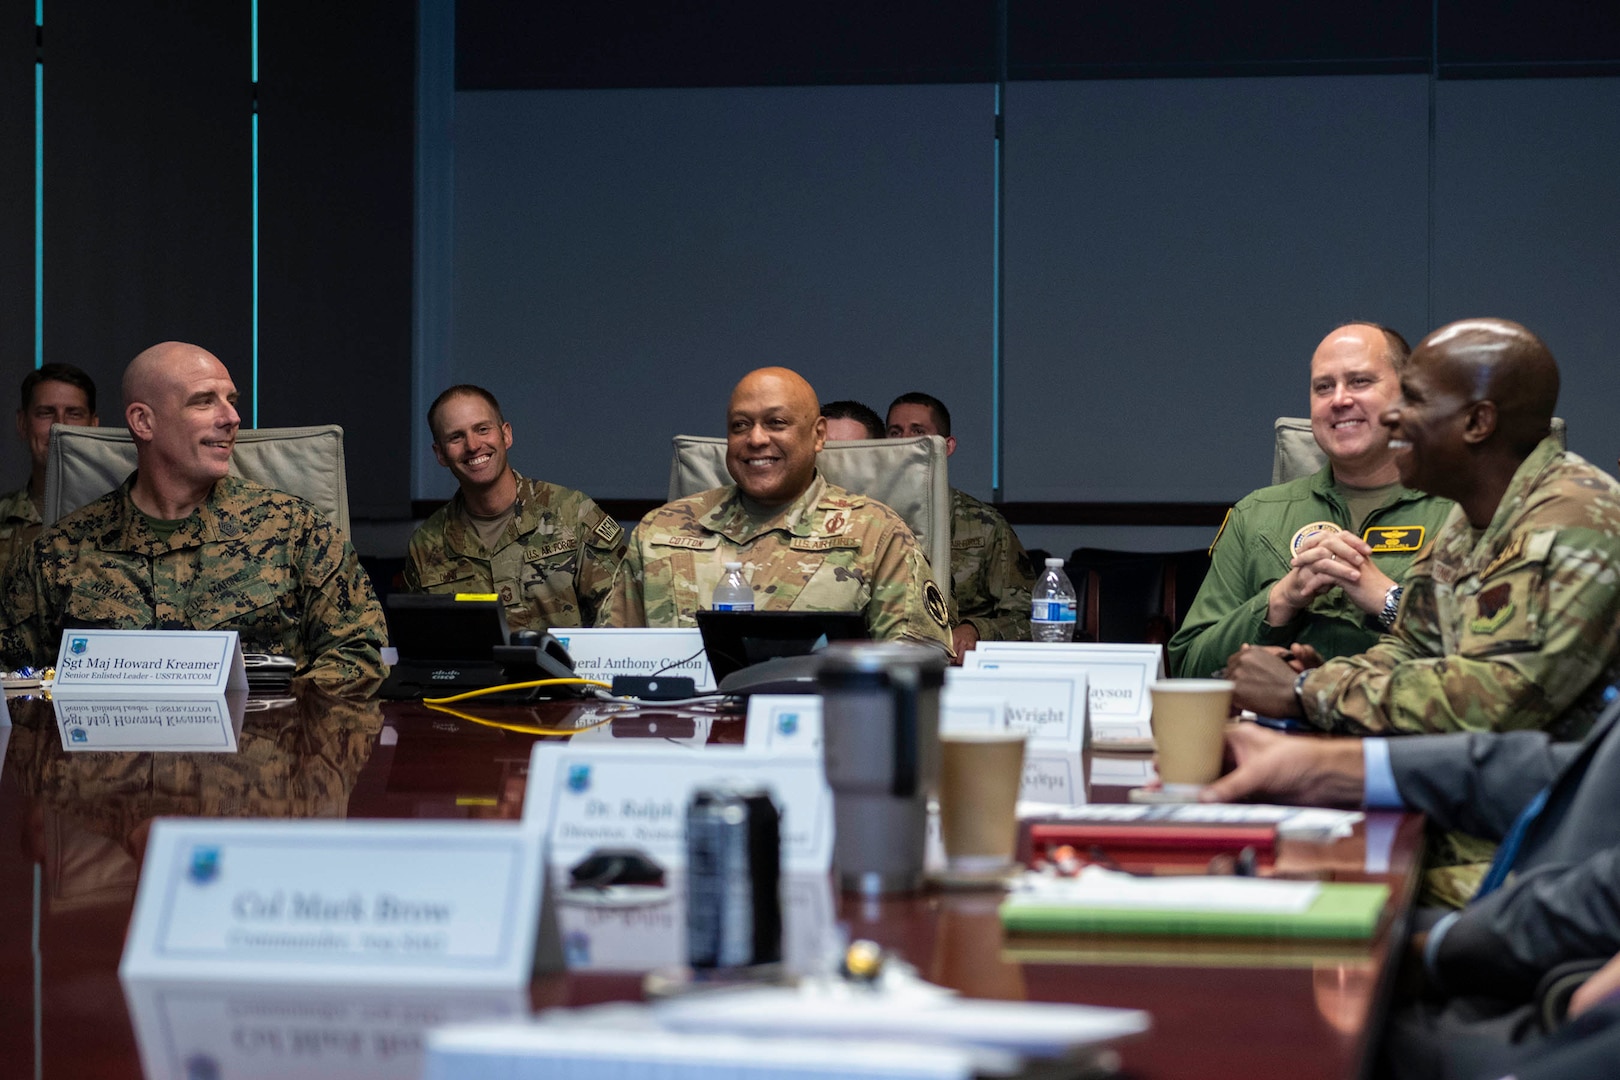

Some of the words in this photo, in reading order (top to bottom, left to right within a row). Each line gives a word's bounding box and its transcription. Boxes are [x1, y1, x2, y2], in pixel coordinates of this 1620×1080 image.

[668, 535, 705, 548] COTTON
[793, 538, 811, 548] U.S.
[812, 539, 828, 549] AIR
[827, 536, 857, 547] FORCE
[526, 551, 540, 559] U.S.
[541, 545, 552, 557] AIR
[553, 539, 577, 553] FORCE
[62, 657, 82, 671] Sgt
[86, 658, 111, 671] Maj
[113, 658, 162, 670] Howard
[165, 659, 220, 670] Kreamer
[603, 657, 657, 671] Anthony
[660, 658, 702, 669] Cotton
[64, 671, 90, 680] Senior
[91, 672, 122, 680] Enlisted
[123, 672, 149, 680] Leader
[155, 672, 212, 680] USSTRATCOM
[1089, 688, 1133, 700] ayson
[1007, 706, 1065, 724] Wright
